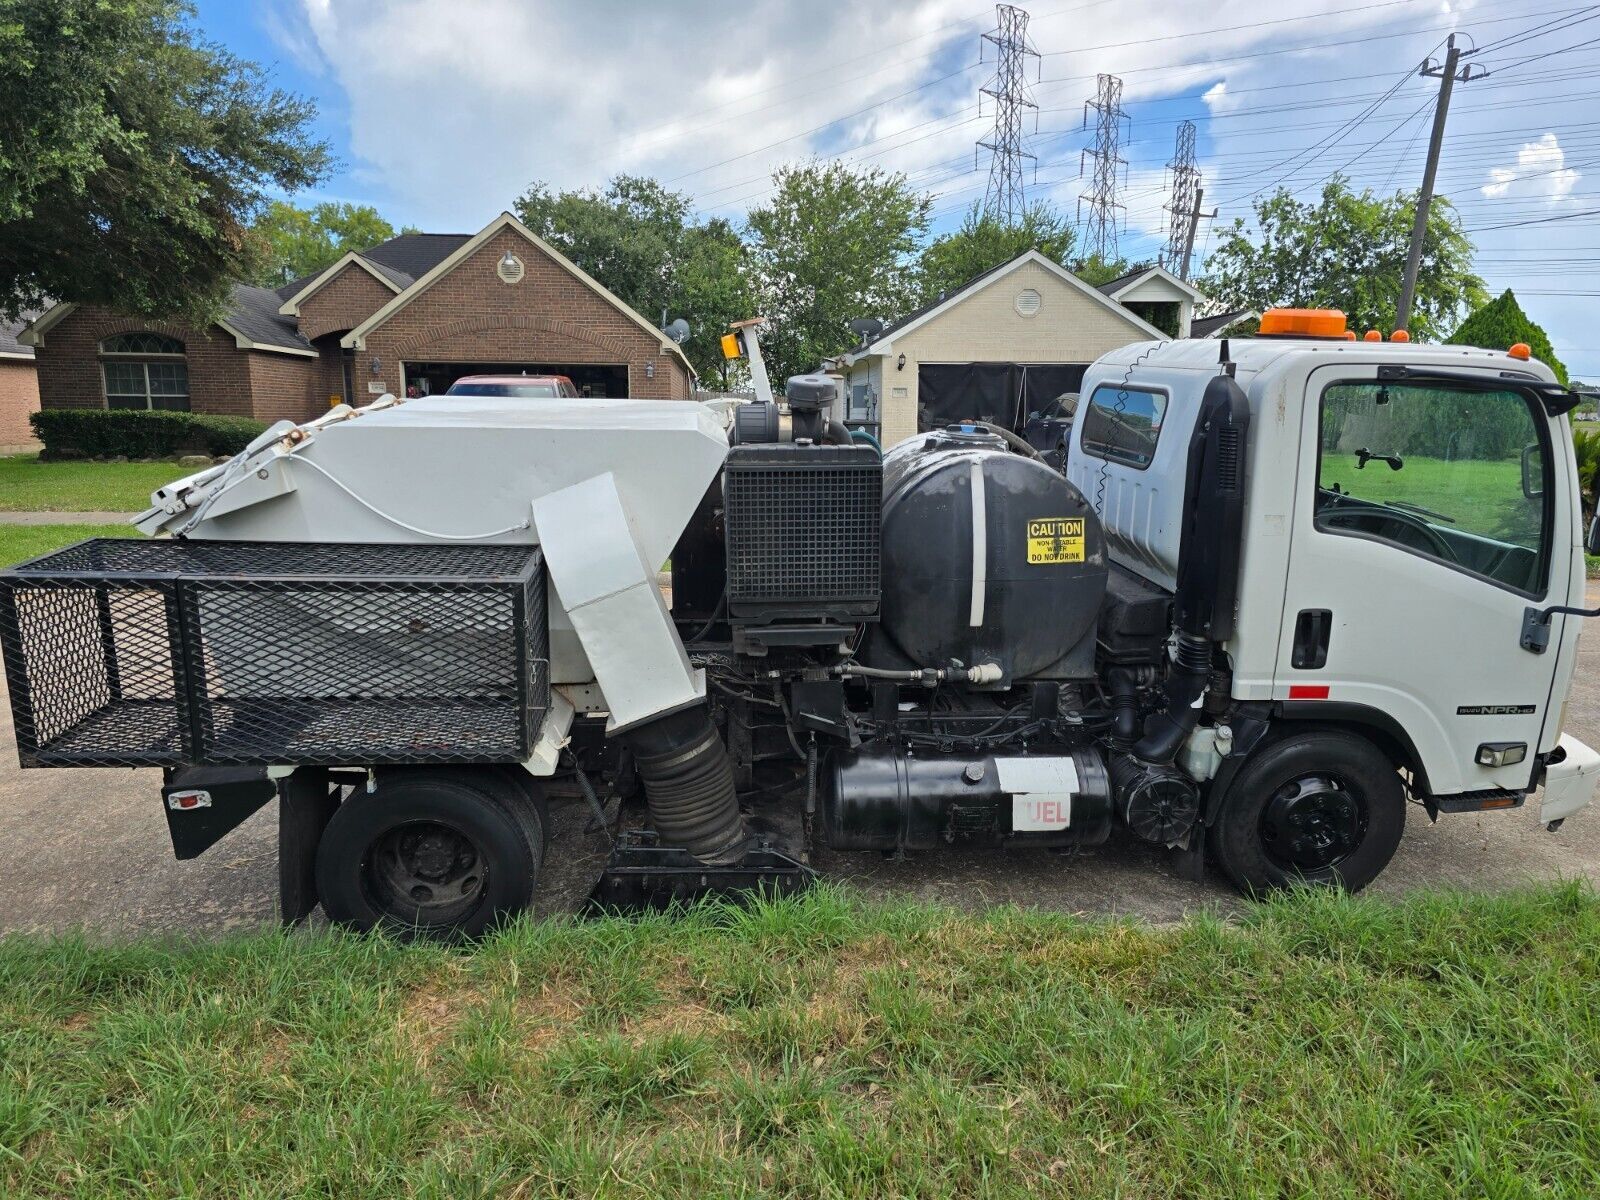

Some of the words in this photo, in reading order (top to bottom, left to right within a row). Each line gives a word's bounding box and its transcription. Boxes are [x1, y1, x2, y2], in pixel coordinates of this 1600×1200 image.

[1030, 522, 1081, 536] CAUTION
[1060, 552, 1080, 560] DRINK
[1481, 706, 1518, 714] NPR
